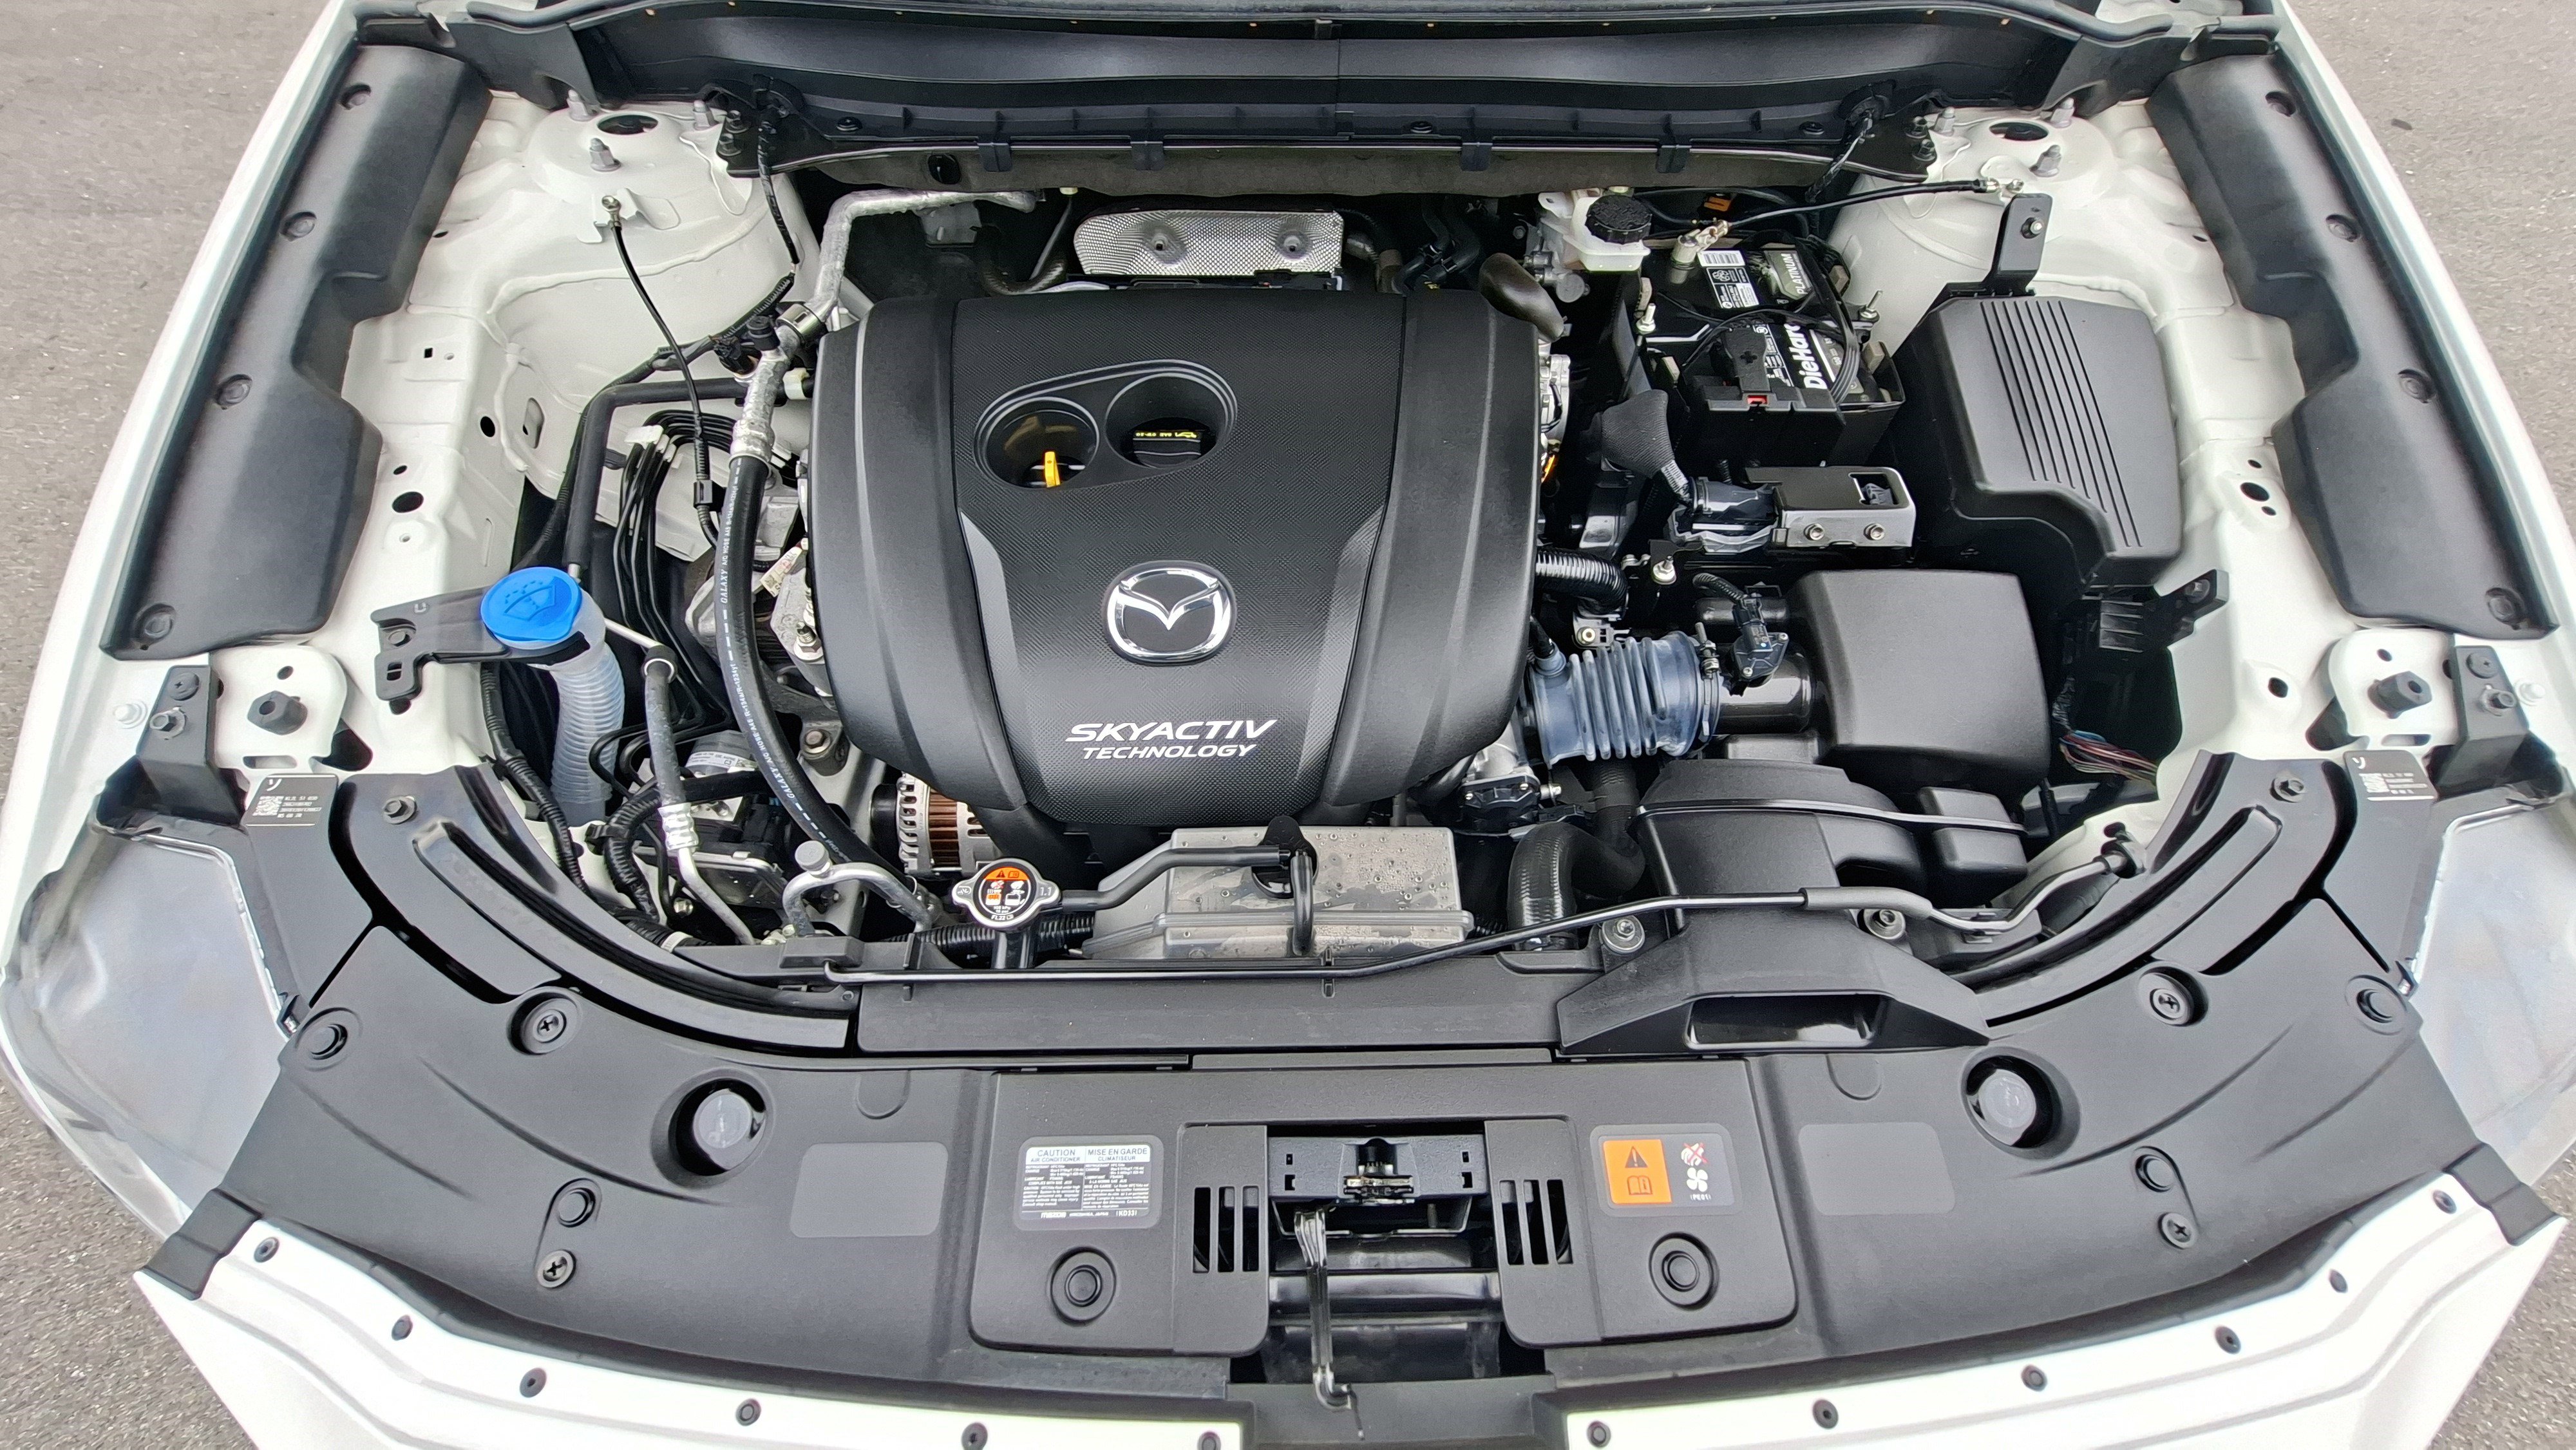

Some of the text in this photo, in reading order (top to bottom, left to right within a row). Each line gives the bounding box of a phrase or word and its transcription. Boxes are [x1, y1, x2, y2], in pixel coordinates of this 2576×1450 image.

[1781, 253, 1808, 294] PLATINUM
[1065, 720, 1278, 742] SKYACTIV
[1083, 744, 1257, 760] TECHNOLOGY
[770, 767, 795, 798] GALAXY
[1040, 887, 1052, 896] 1.1
